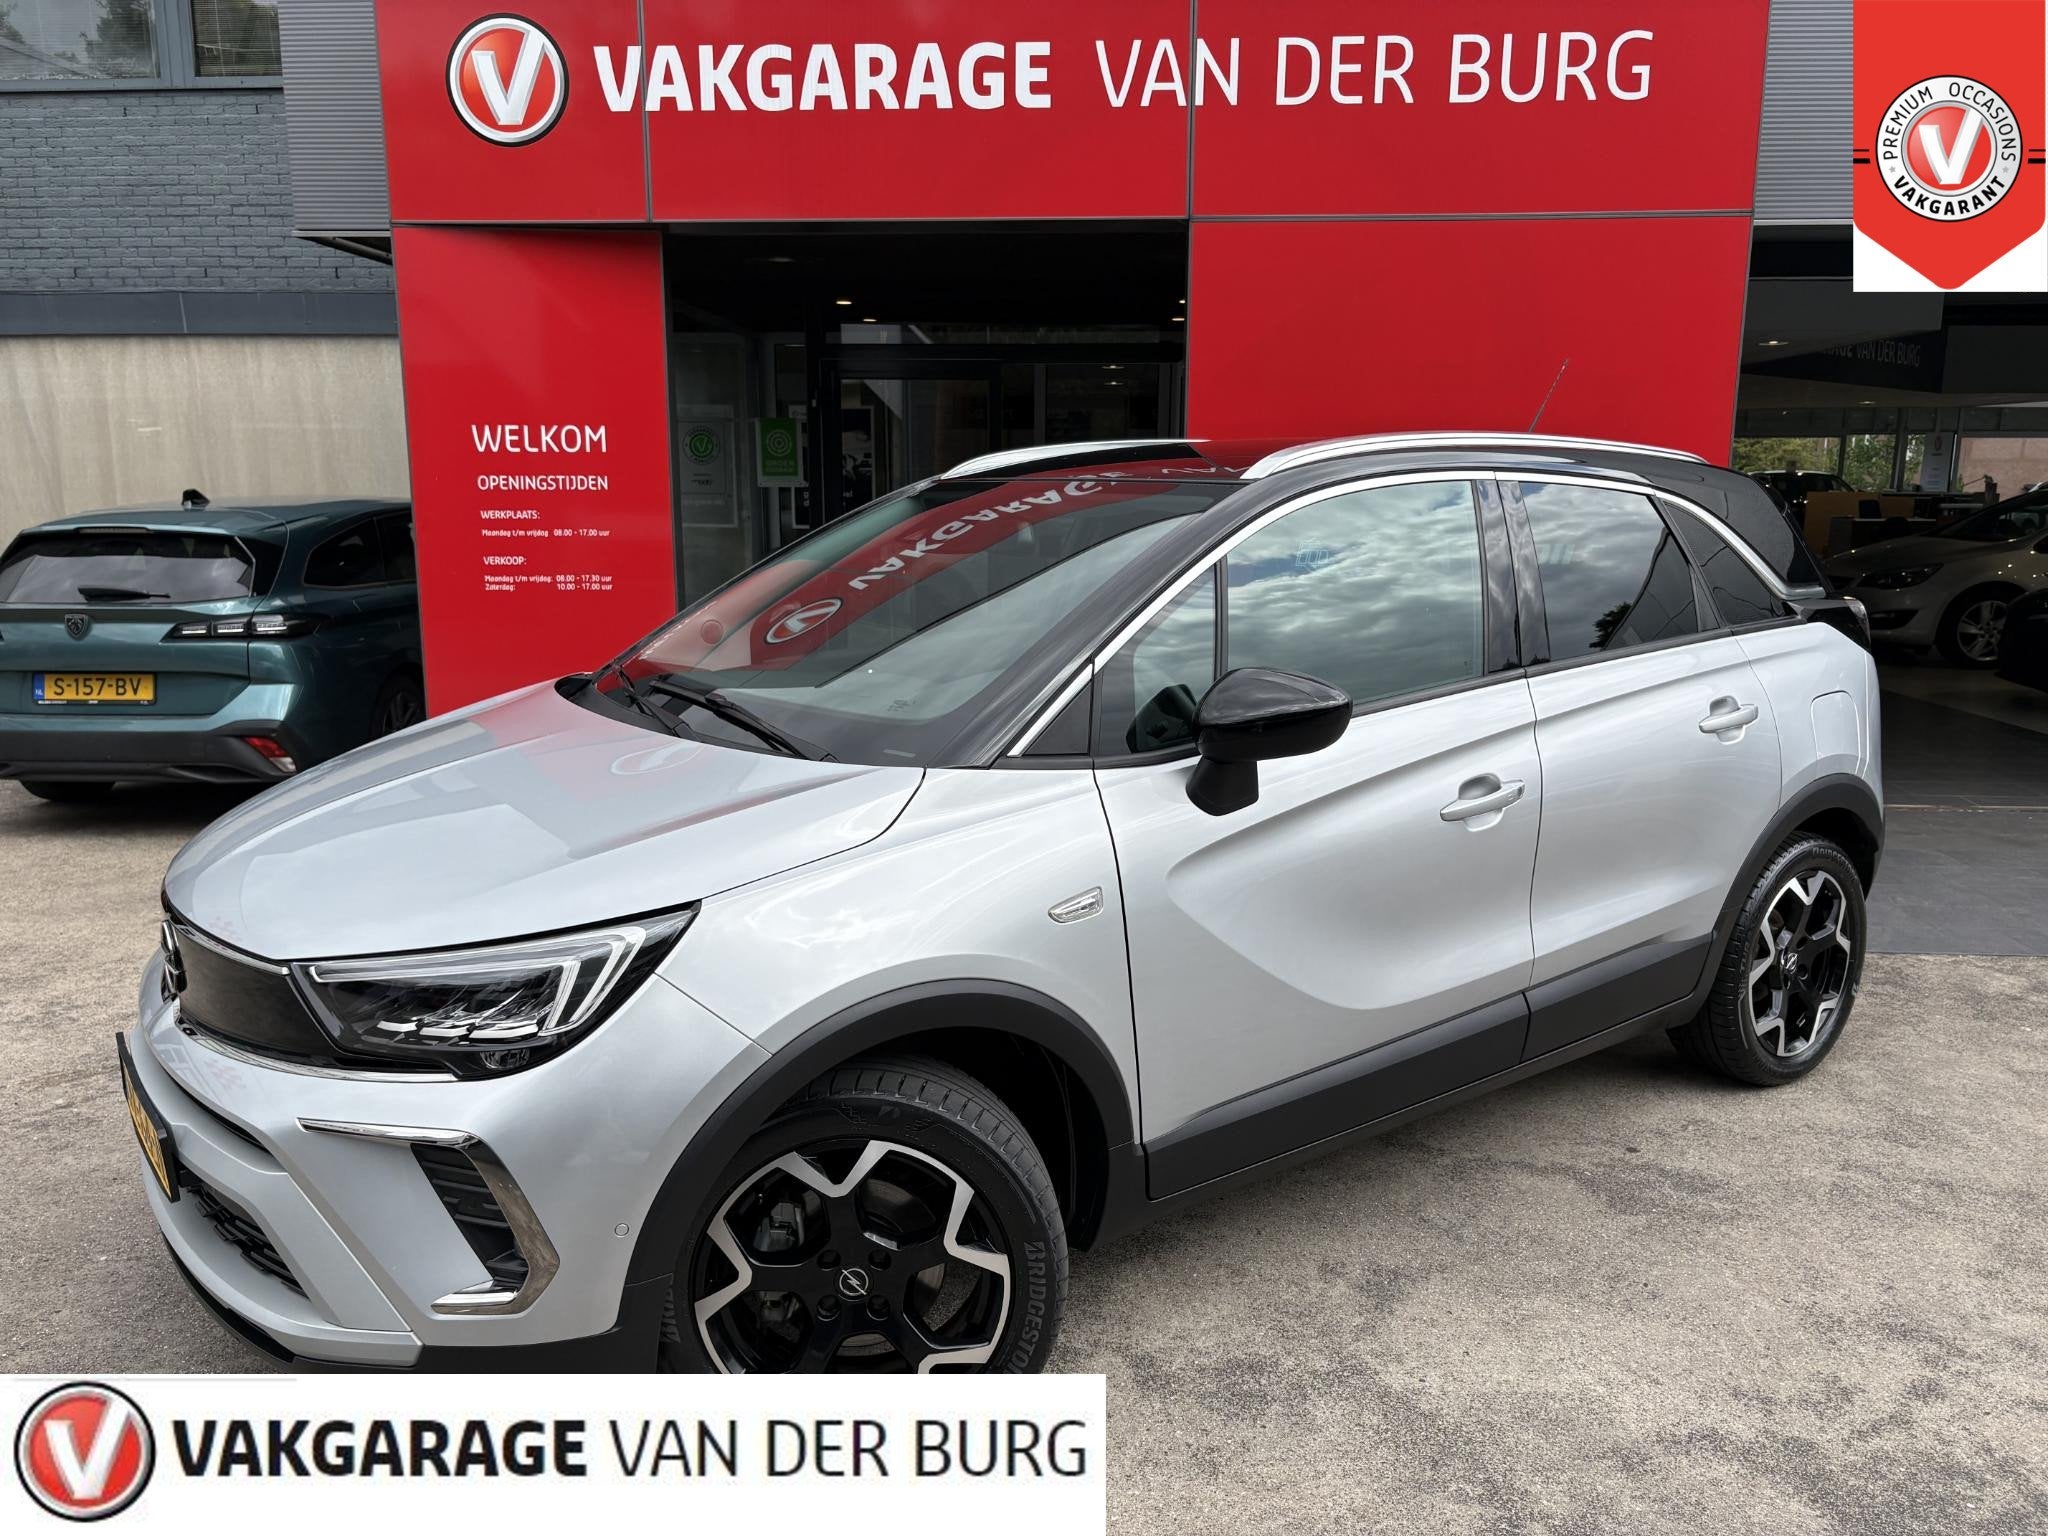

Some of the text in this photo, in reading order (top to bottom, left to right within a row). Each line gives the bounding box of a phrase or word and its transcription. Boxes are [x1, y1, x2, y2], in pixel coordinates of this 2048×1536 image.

[593, 41, 1052, 113] VAKGARAGE
[1094, 38, 1240, 107] VAN
[1275, 34, 1415, 106] DER
[1448, 30, 1654, 103] BURG
[471, 424, 607, 453] WELKOM
[477, 475, 609, 491] OPENINGSTIJDEN
[480, 510, 541, 520] WERKPLAATS:
[482, 529, 511, 537] Maandag
[512, 529, 525, 537] t/m
[483, 556, 527, 565] VERKOOP:
[484, 575, 514, 583] Maandag
[515, 575, 528, 583] t/m
[485, 583, 516, 592] Zaterdag:
[557, 583, 576, 591] 10.00
[581, 583, 600, 591] 17.00
[53, 677, 142, 696] S-157-BV
